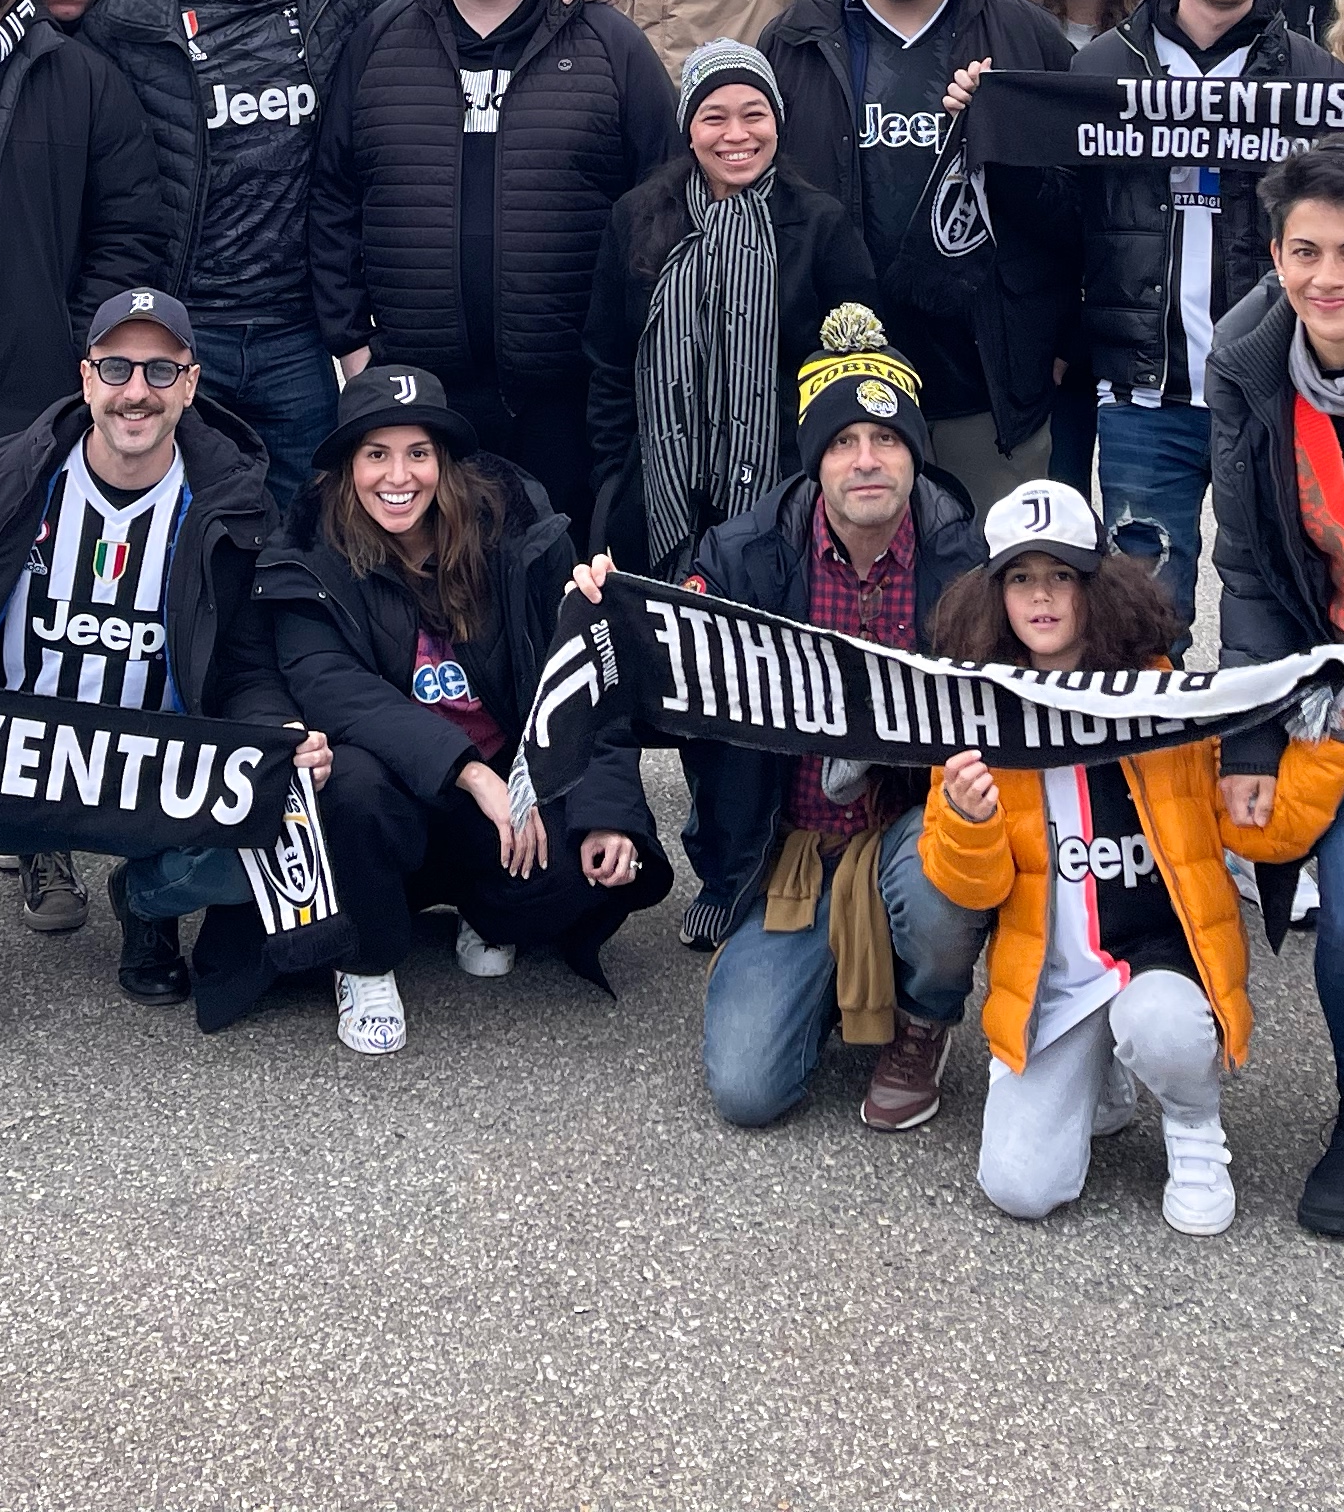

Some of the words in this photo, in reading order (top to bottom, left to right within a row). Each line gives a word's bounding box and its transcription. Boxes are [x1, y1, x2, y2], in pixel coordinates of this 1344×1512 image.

[207, 83, 316, 130] Jeep
[1076, 123, 1144, 157] Club
[1151, 126, 1210, 159] DOC
[32, 600, 167, 661] Jeep
[1049, 821, 1155, 889] eep
